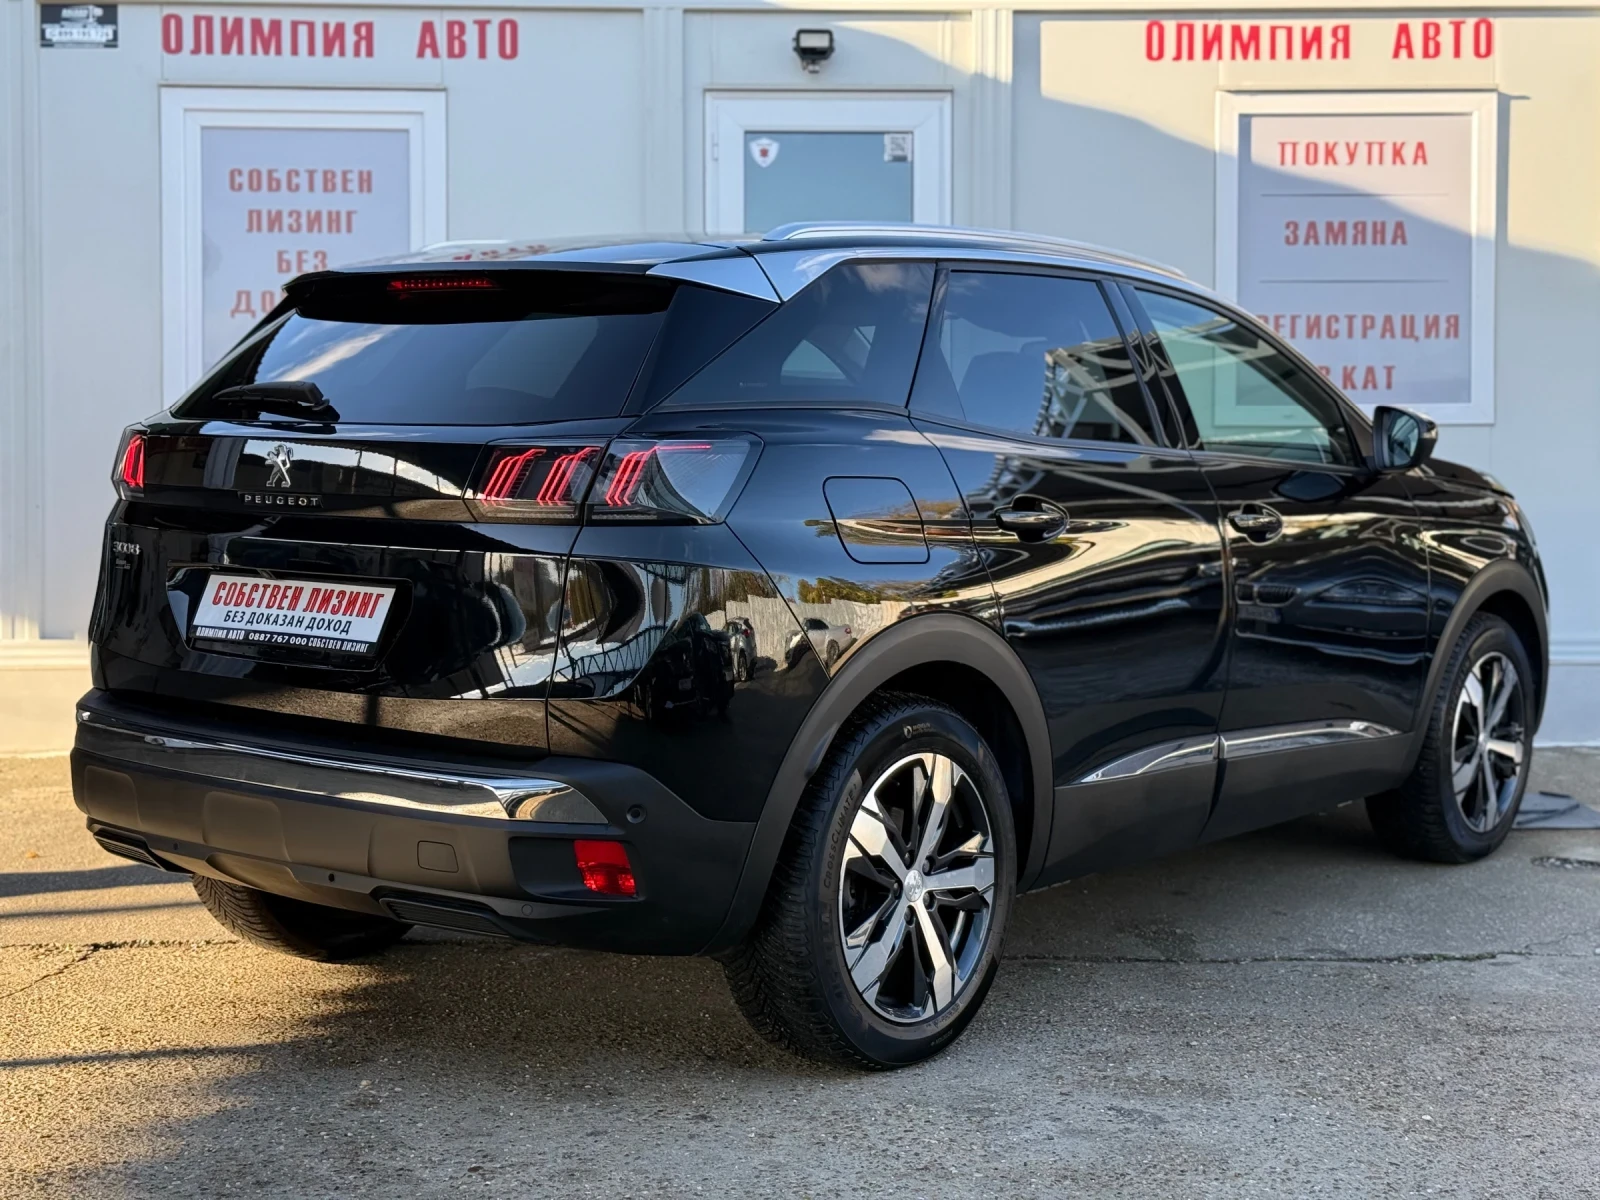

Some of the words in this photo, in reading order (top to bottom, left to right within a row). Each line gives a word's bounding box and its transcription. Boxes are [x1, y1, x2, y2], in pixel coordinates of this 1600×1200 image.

[161, 13, 375, 58] ОЛИМПИЯ
[416, 18, 519, 61] АВТО
[1145, 20, 1351, 62] ОЛИМПИЯ
[1392, 17, 1494, 60] АВТО
[1278, 141, 1428, 166] ПОКУПКА
[228, 168, 373, 194] СОБСТВЕН
[246, 209, 358, 234] ЛИЗИНГ
[1285, 220, 1408, 246] ЗАМЯНА
[277, 250, 328, 274] БЕЗ
[1341, 365, 1396, 390] КАТ
[244, 494, 319, 506] PEUGEOT
[112, 541, 141, 556] 3008
[212, 581, 304, 612] СОБСТВЕН
[302, 587, 385, 619] ЛИЗИНГ
[223, 610, 246, 623] БЕЗ
[246, 611, 305, 629] ДОКАЗАН
[304, 616, 352, 636] ДОХОД
[227, 629, 245, 640] АВТО
[248, 632, 271, 643] 0887
[271, 634, 289, 644] 767
[289, 636, 308, 646] 000
[308, 637, 342, 651] СОБСТВЕН
[341, 641, 370, 653] ЛИЗИНГ
